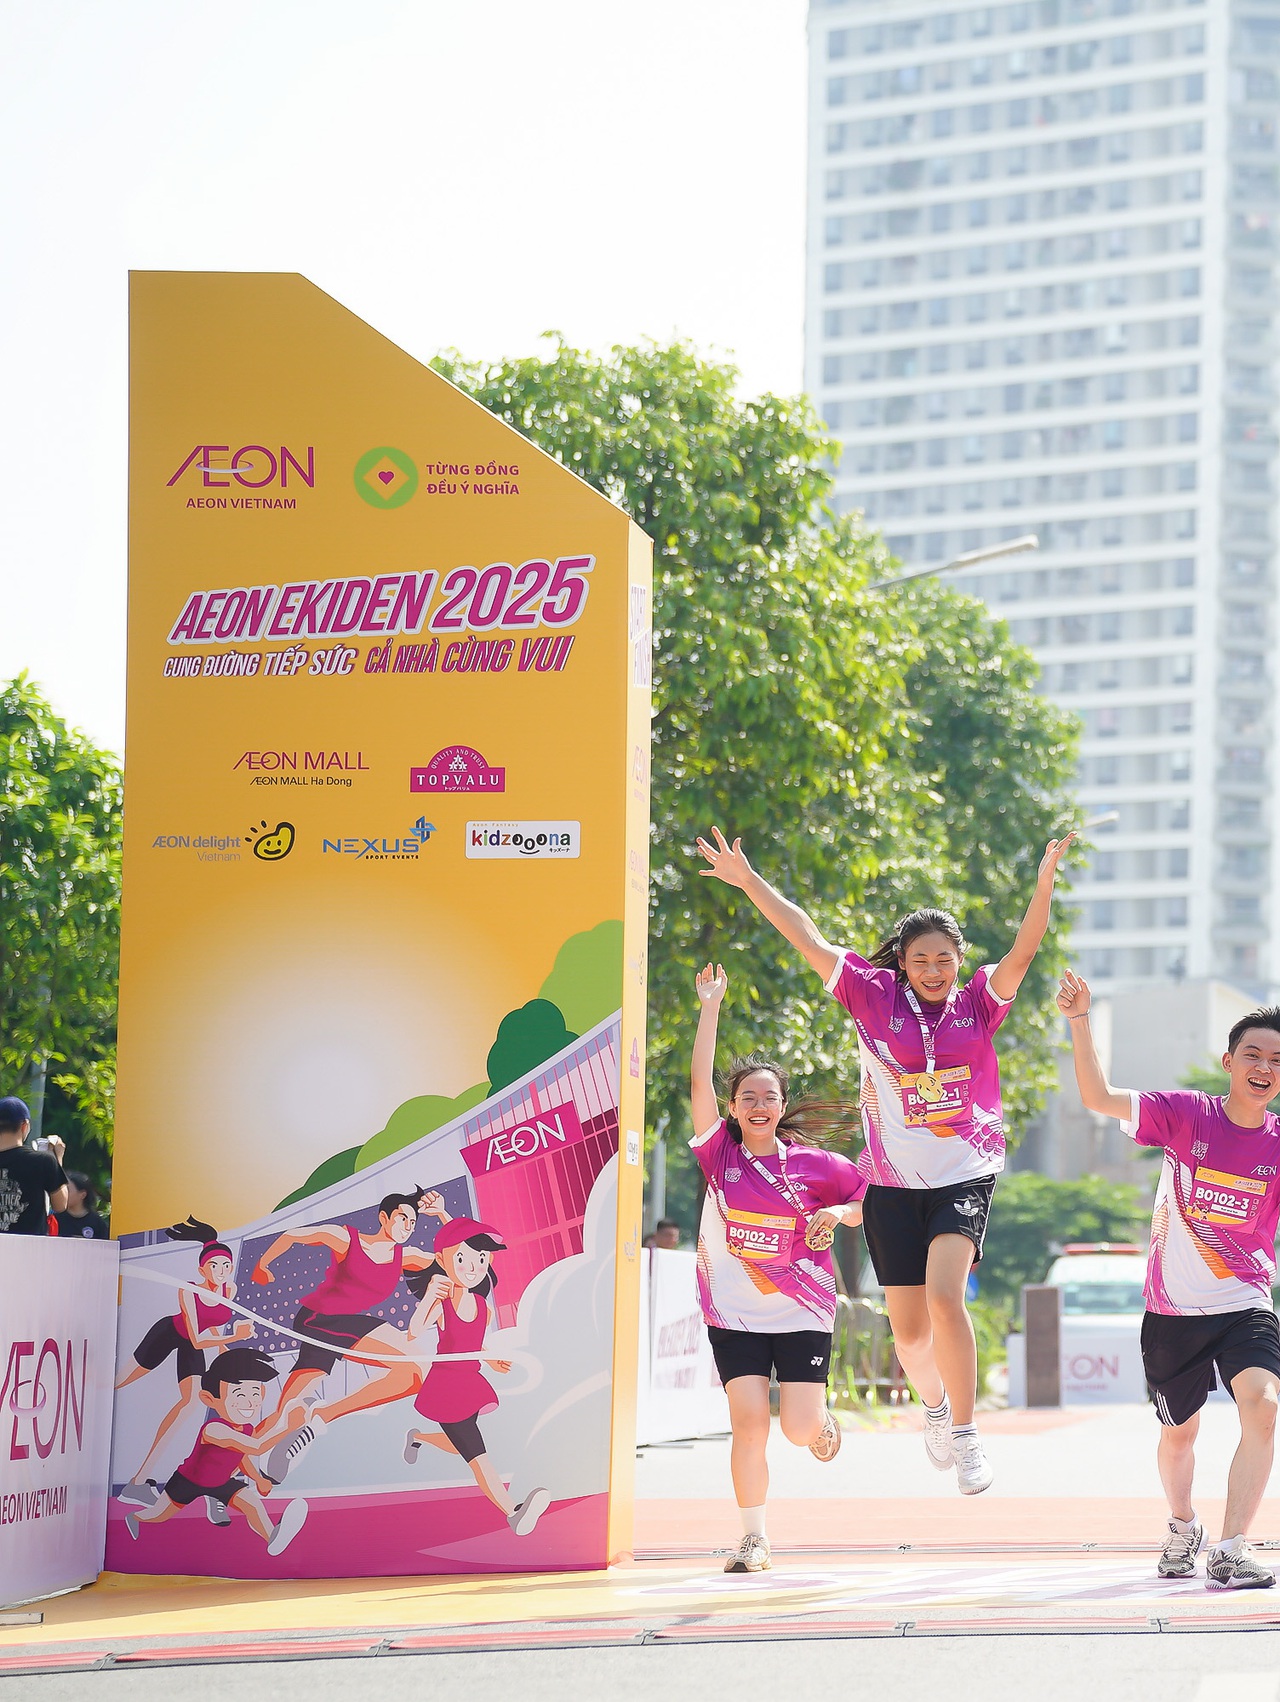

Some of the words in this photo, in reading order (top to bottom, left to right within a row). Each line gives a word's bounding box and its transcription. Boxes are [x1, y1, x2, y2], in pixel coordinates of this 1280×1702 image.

[426, 461, 470, 475] TỪNG
[474, 460, 519, 476] ĐỒNG
[427, 479, 457, 495] ĐỀU
[460, 480, 470, 495] Ý
[473, 481, 520, 495] NGHĨA
[186, 498, 227, 509] AEON
[230, 498, 296, 509] VIETNAM
[168, 587, 276, 642] AEON
[266, 572, 435, 637] EKIDEN
[430, 556, 592, 629] 2025
[163, 656, 203, 677] CUNG
[202, 651, 261, 677] ĐƯỜNG
[263, 643, 309, 676] TIẾP
[308, 643, 358, 676] SỨC
[364, 638, 393, 673] CẢ
[392, 637, 440, 673] NHÀ
[441, 635, 515, 673] CÙNG
[517, 635, 575, 672] VUI
[304, 752, 370, 770] MALL
[280, 777, 308, 785] MALL
[311, 777, 323, 785] Ha
[326, 777, 352, 787] Dong
[417, 775, 499, 785] TOPVALU
[192, 835, 241, 850] delight
[472, 830, 570, 850] kidzooona
[197, 851, 241, 862] Vietnam
[323, 838, 419, 860] NEXUS
[25, 1485, 67, 1520] VIETNAM
